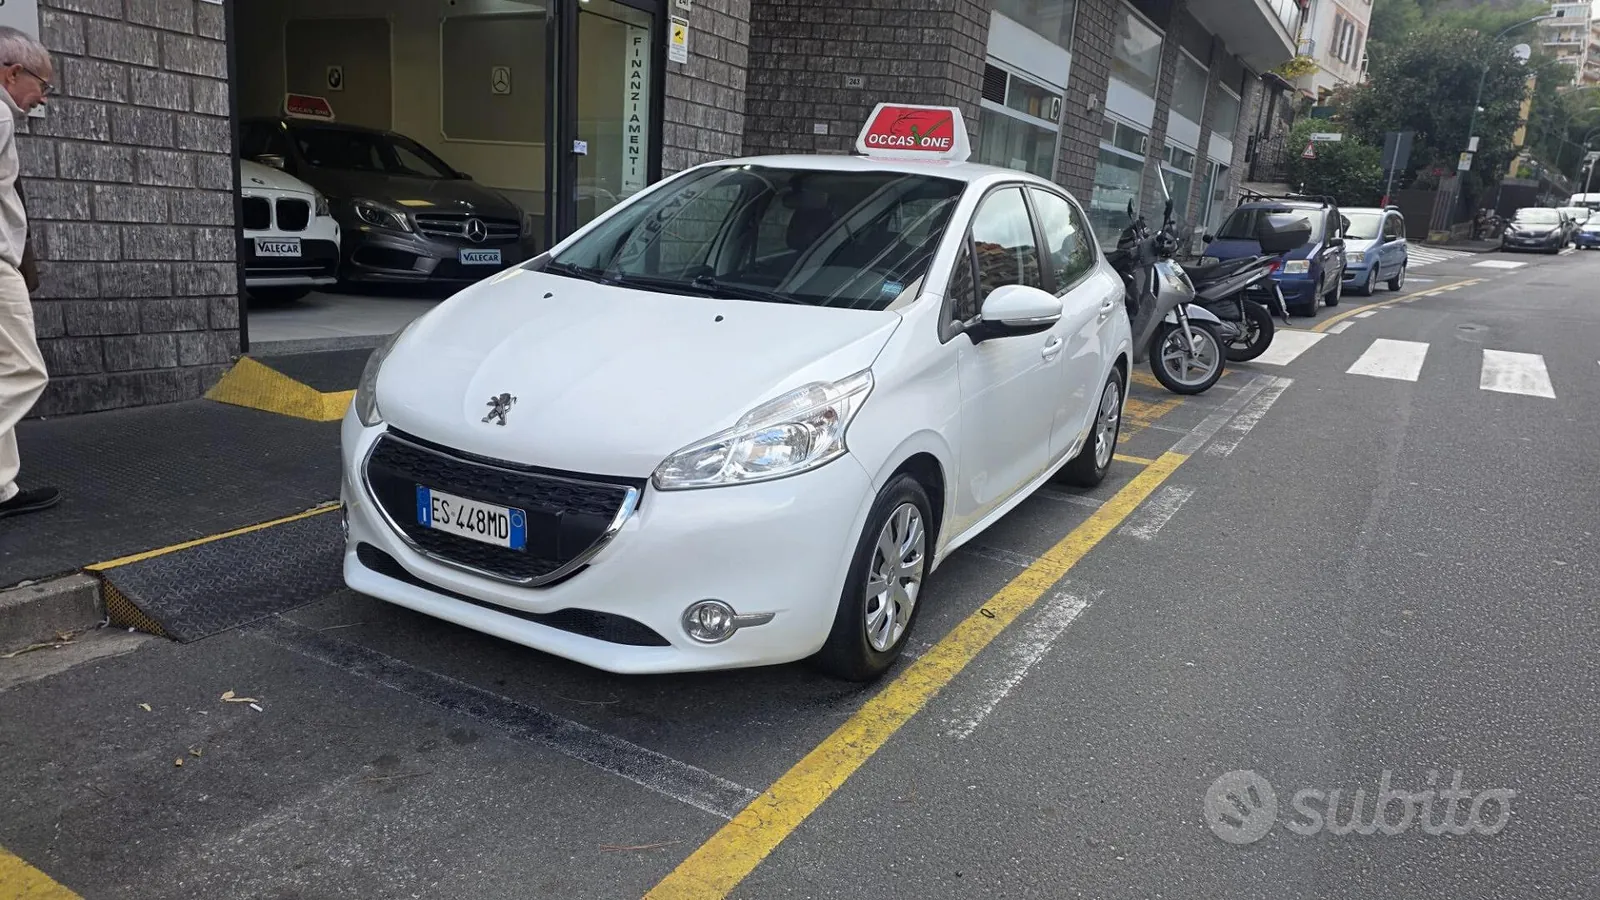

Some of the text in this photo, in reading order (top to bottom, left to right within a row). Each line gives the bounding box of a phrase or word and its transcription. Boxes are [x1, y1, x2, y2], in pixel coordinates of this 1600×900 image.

[628, 37, 642, 175] FINANZIAMENTI
[258, 241, 299, 253] VALECAR
[463, 252, 499, 261] VALECAR
[431, 498, 508, 539] ES 448MD
